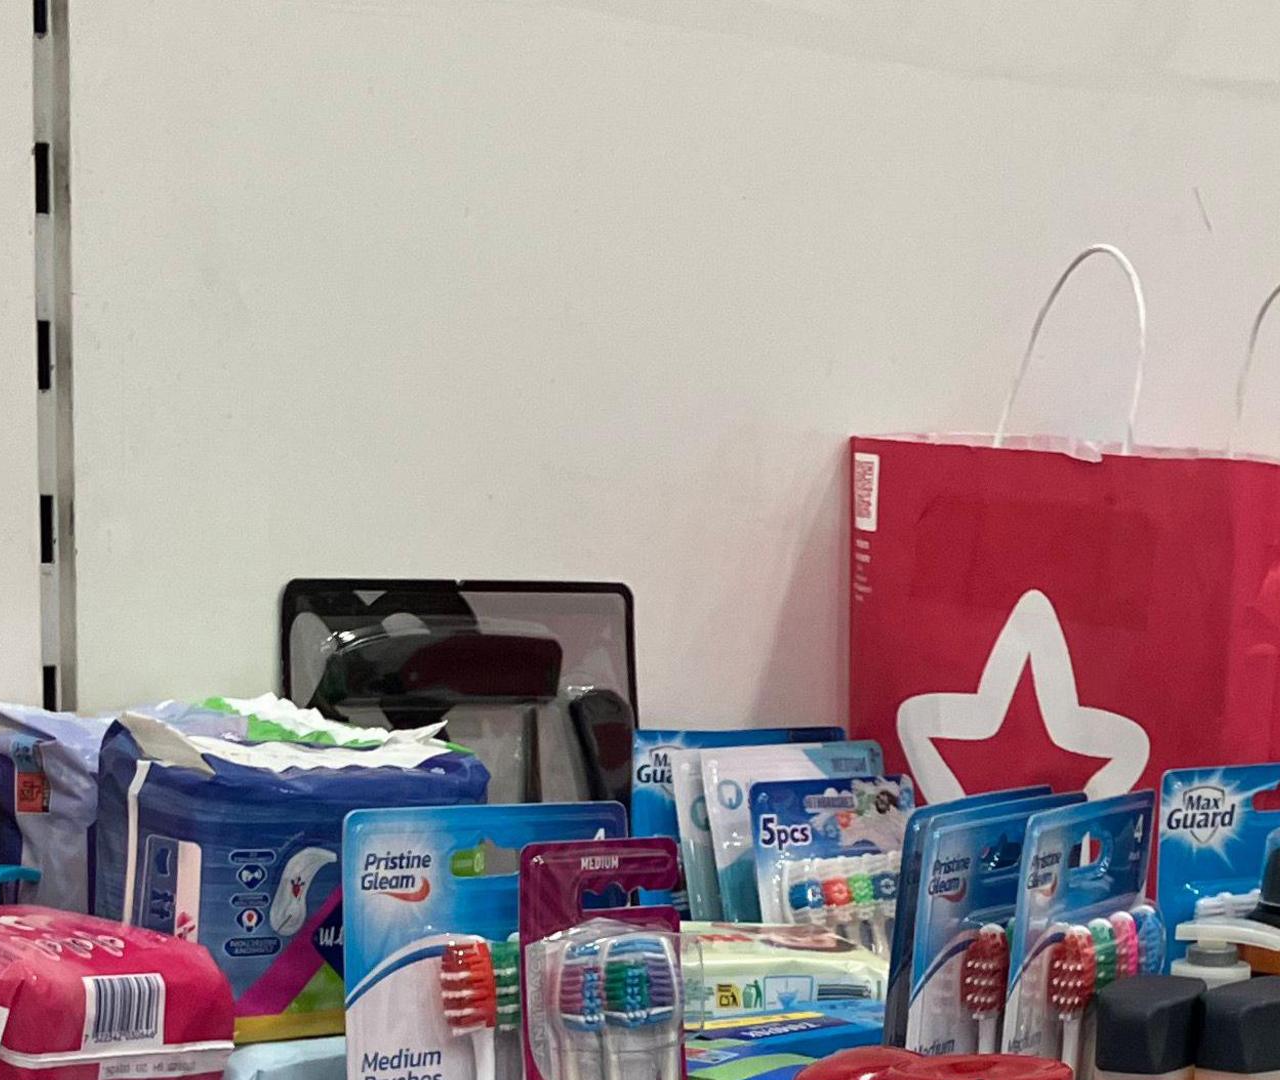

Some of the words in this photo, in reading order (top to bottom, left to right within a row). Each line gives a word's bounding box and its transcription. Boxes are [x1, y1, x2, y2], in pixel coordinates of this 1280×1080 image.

[1185, 795, 1221, 811] Max
[1167, 803, 1236, 829] Guard
[760, 814, 811, 849] 5pcs
[363, 851, 432, 871] Pristine
[580, 854, 620, 870] MEDIUM
[933, 855, 972, 876] Pristine
[360, 872, 417, 891] Gleam
[927, 876, 962, 895] Gleam
[361, 1048, 442, 1074] Medium
